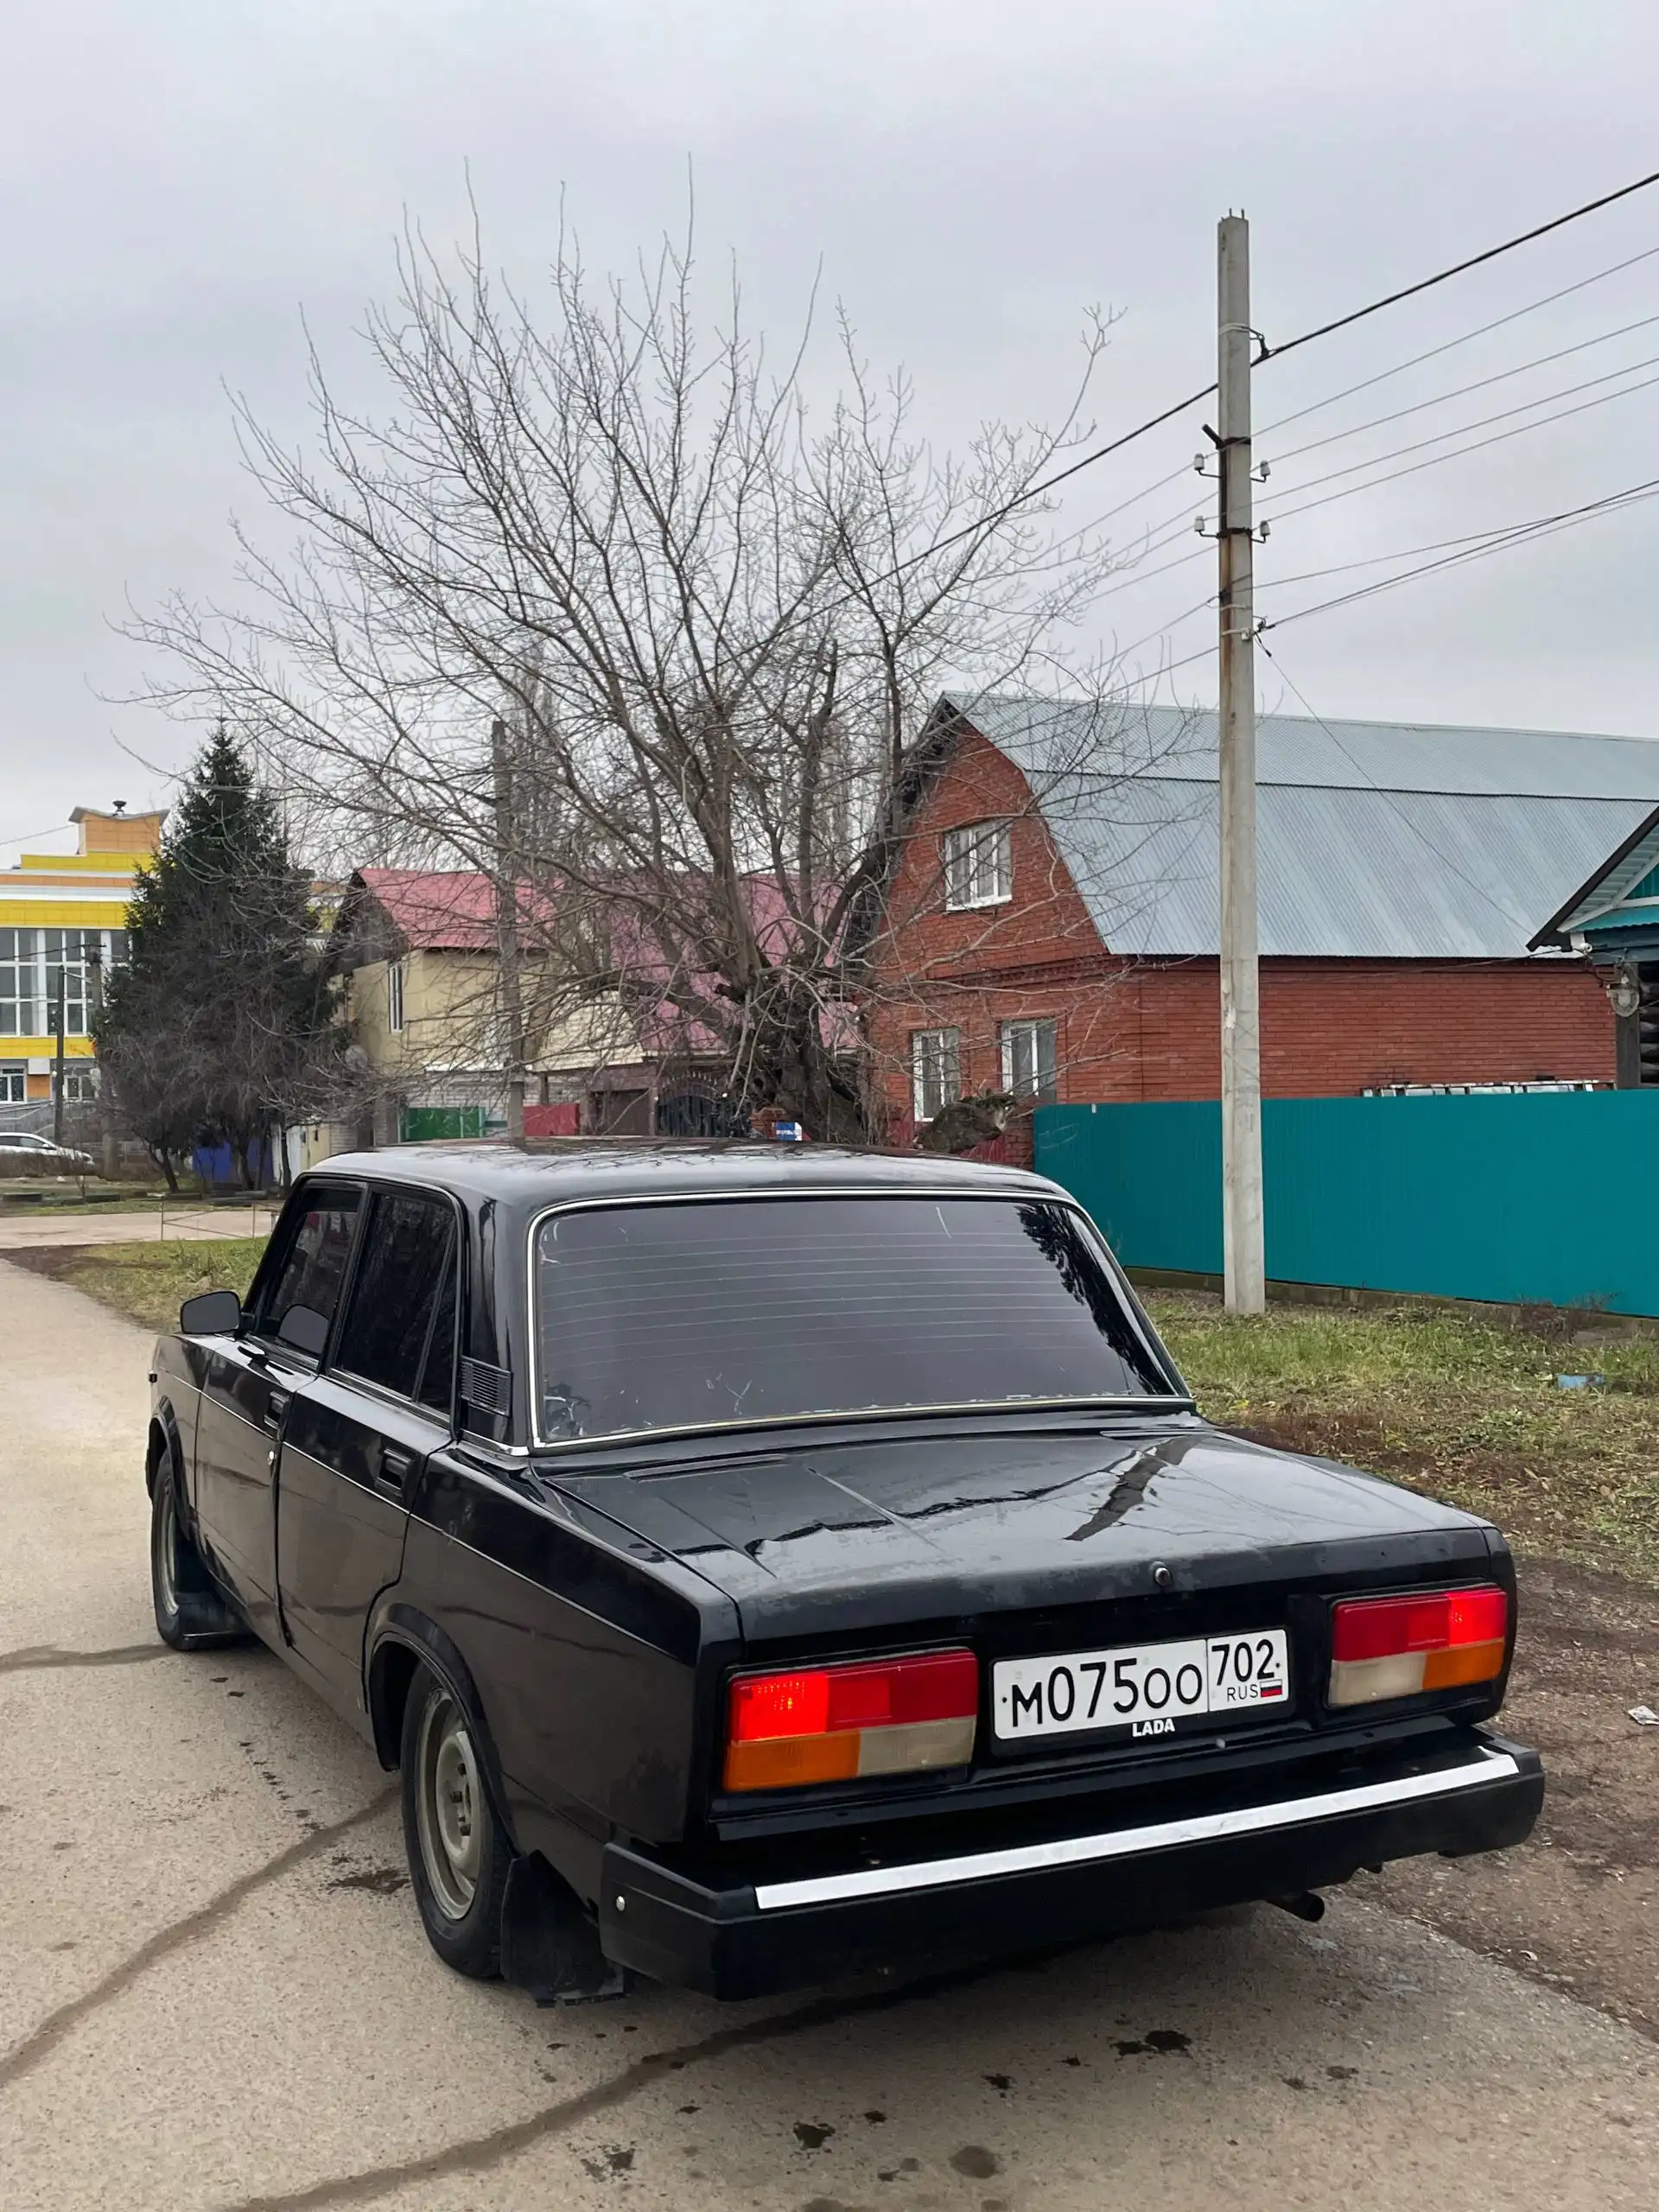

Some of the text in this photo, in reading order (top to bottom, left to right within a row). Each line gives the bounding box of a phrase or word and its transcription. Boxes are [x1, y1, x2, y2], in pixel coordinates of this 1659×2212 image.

[1211, 1639, 1274, 1686] 702
[1227, 1684, 1258, 1702] RUS
[1132, 1718, 1176, 1738] LADA
